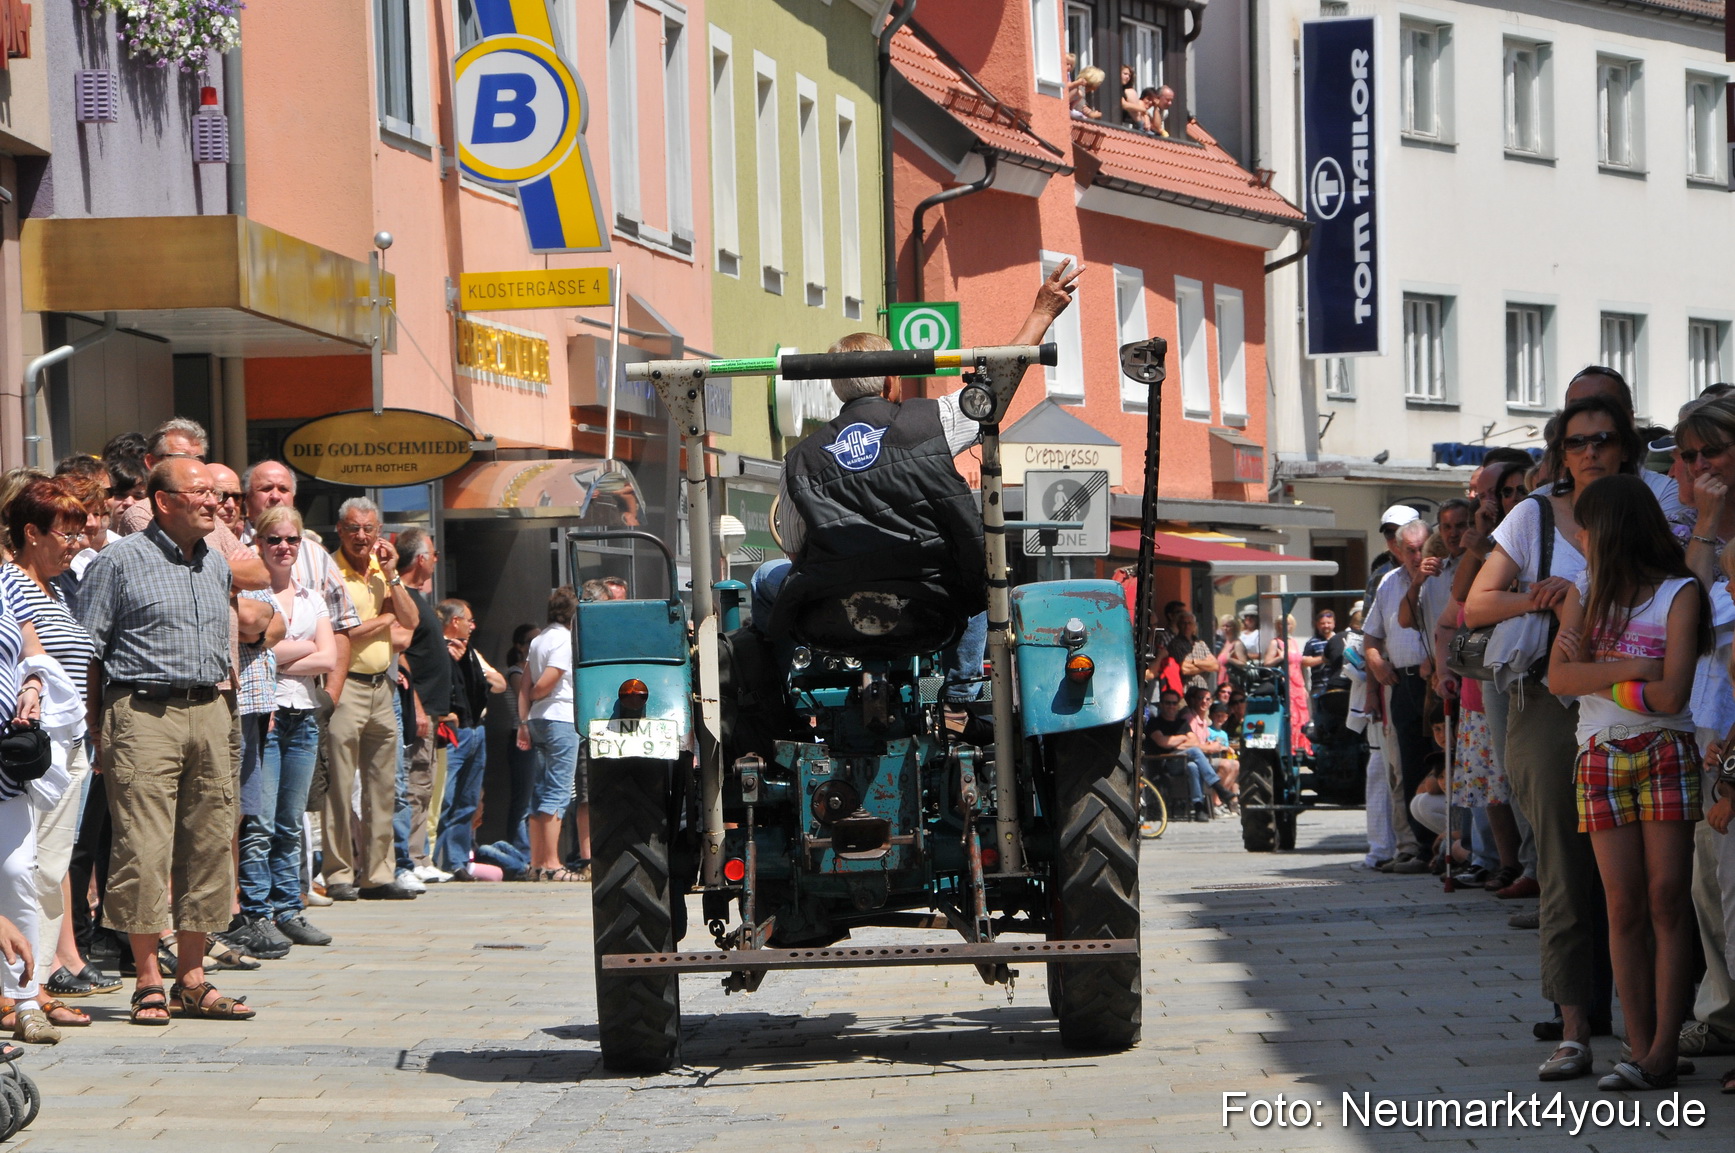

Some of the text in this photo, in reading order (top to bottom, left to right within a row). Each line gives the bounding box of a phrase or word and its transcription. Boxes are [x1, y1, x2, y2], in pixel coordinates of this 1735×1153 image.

[471, 72, 537, 144] B
[1350, 48, 1372, 324] TOM TAILOR
[468, 279, 600, 299] KLOSTERGASSE 4
[293, 440, 469, 458] DIE GOLDSCHMIEDE
[1024, 445, 1099, 469] Creppresso
[341, 462, 418, 474] JUTTA ROTHER
[1057, 533, 1088, 547] ONE
[619, 720, 652, 738] NM
